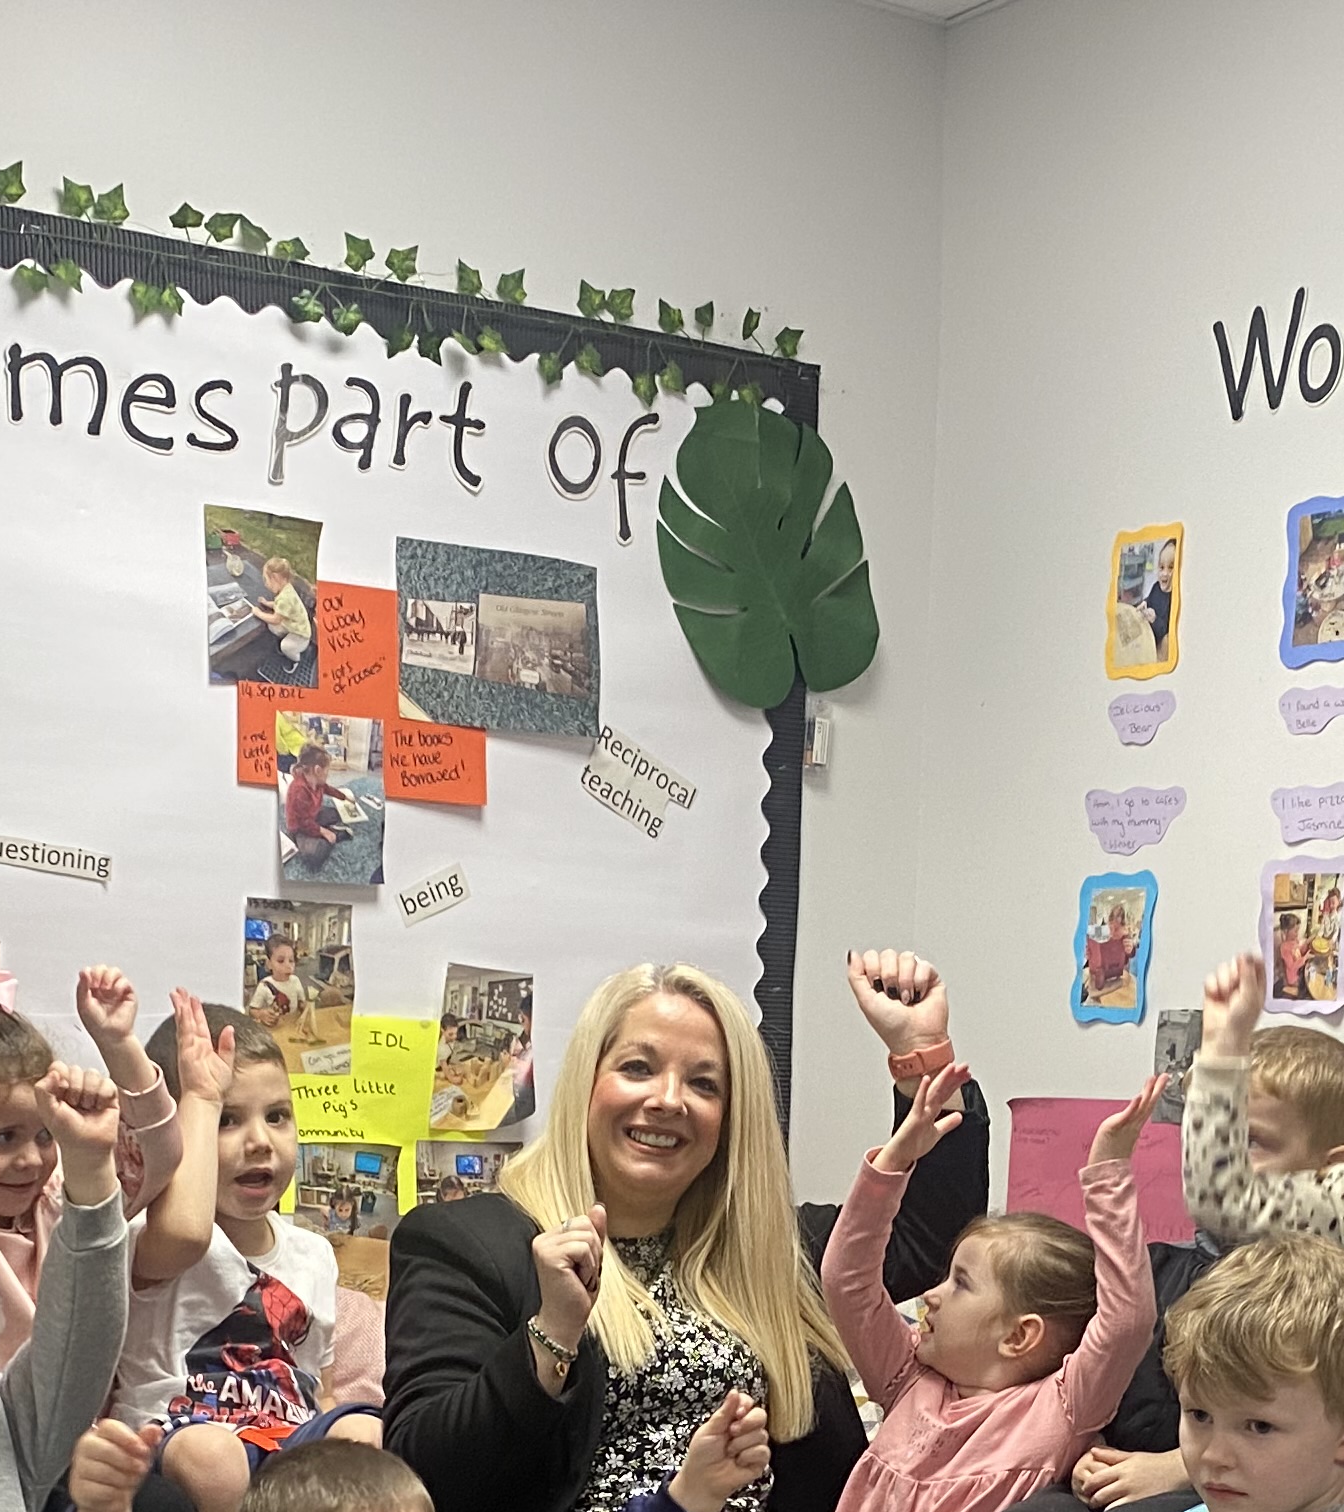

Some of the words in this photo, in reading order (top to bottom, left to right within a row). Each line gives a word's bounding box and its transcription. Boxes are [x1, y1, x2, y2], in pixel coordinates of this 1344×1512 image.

[272, 364, 485, 490] part
[548, 412, 659, 542] of
[242, 683, 252, 698] 14
[1296, 698, 1319, 712] found
[392, 730, 414, 748] The
[412, 752, 442, 767] have
[597, 725, 696, 809] Reciprocal
[581, 764, 663, 838] teaching
[1124, 798, 1135, 817] go
[1141, 798, 1150, 806] to
[1291, 796, 1312, 808] like
[1298, 818, 1344, 832] Jasmine
[400, 872, 466, 916] being
[368, 1030, 410, 1052] IDL
[291, 1083, 340, 1100] Three
[353, 1079, 396, 1096] little
[298, 1126, 364, 1139] ommunity
[188, 1373, 217, 1393] the
